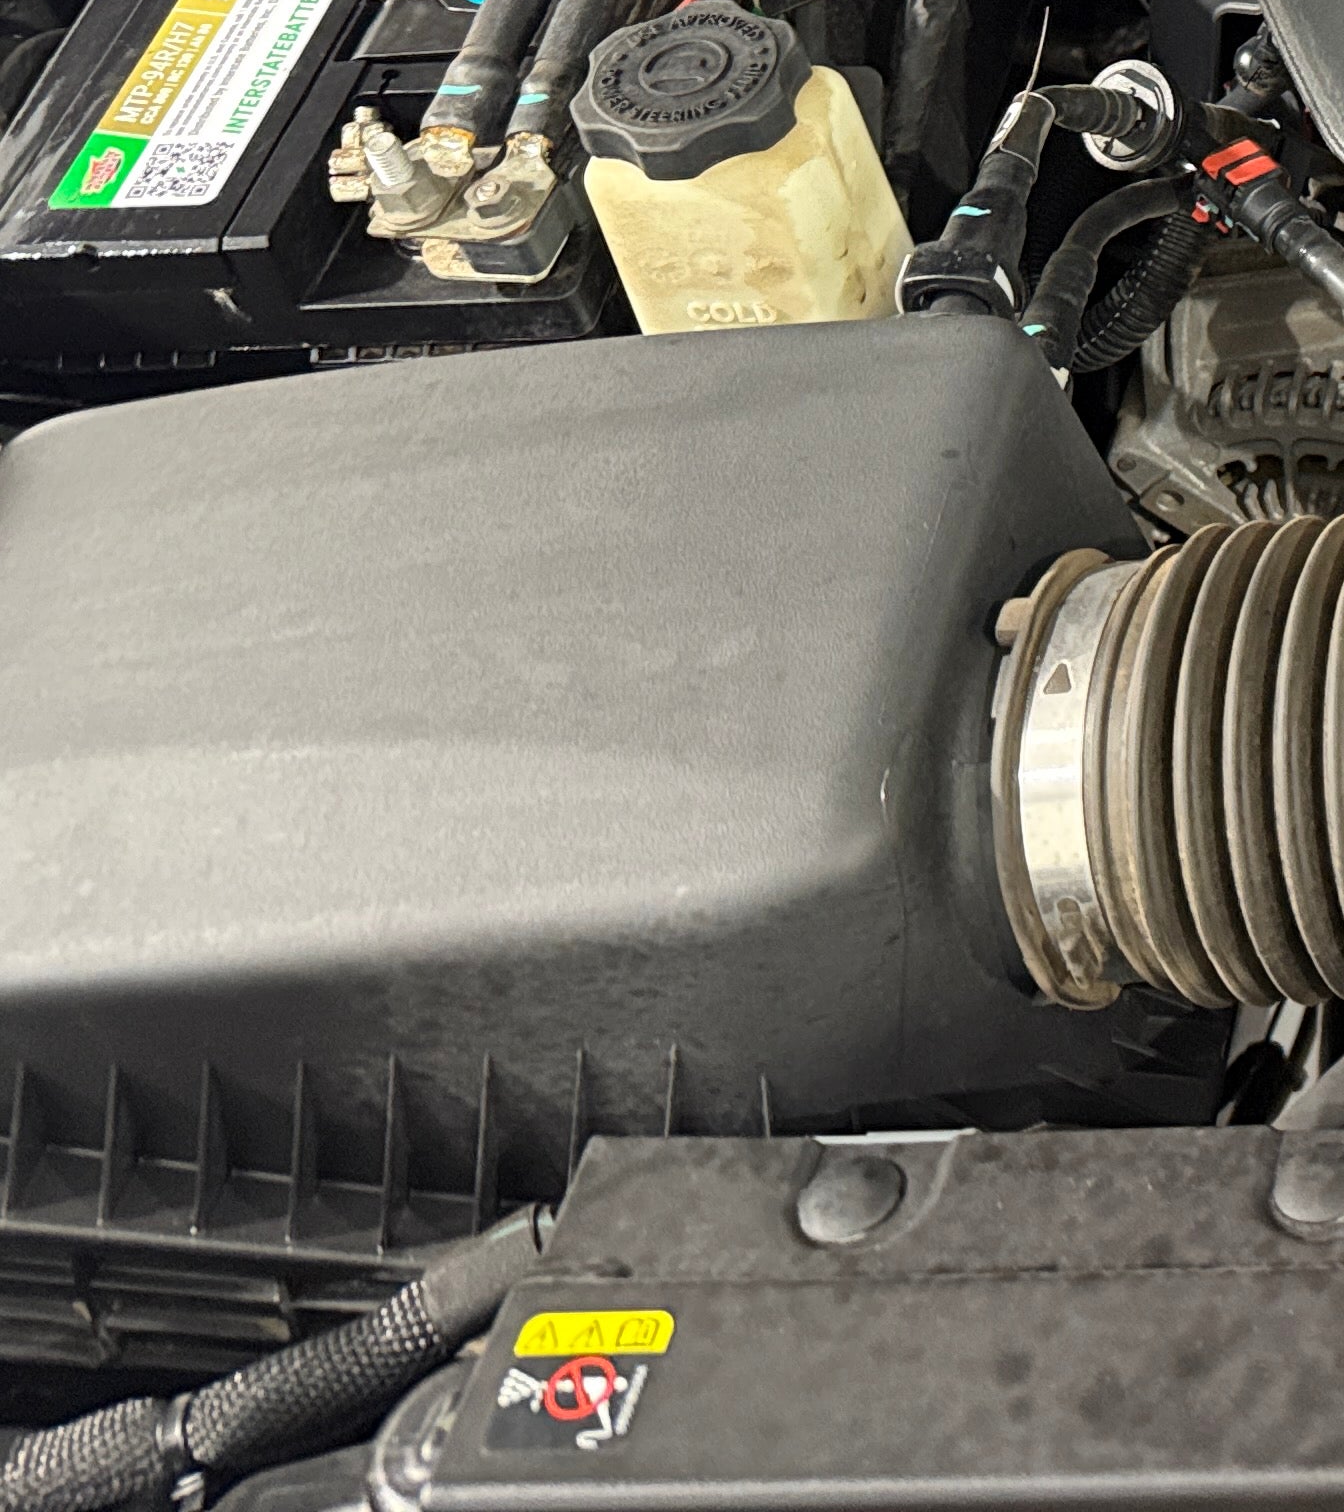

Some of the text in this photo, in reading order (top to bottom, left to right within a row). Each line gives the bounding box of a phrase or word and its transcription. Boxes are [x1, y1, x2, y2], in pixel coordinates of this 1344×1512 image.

[670, 13, 767, 40] APPROVED
[114, 19, 196, 124] MTP-94R/H7
[601, 68, 636, 114] POWER
[630, 98, 728, 122] STEERING
[687, 299, 777, 324] COLD
